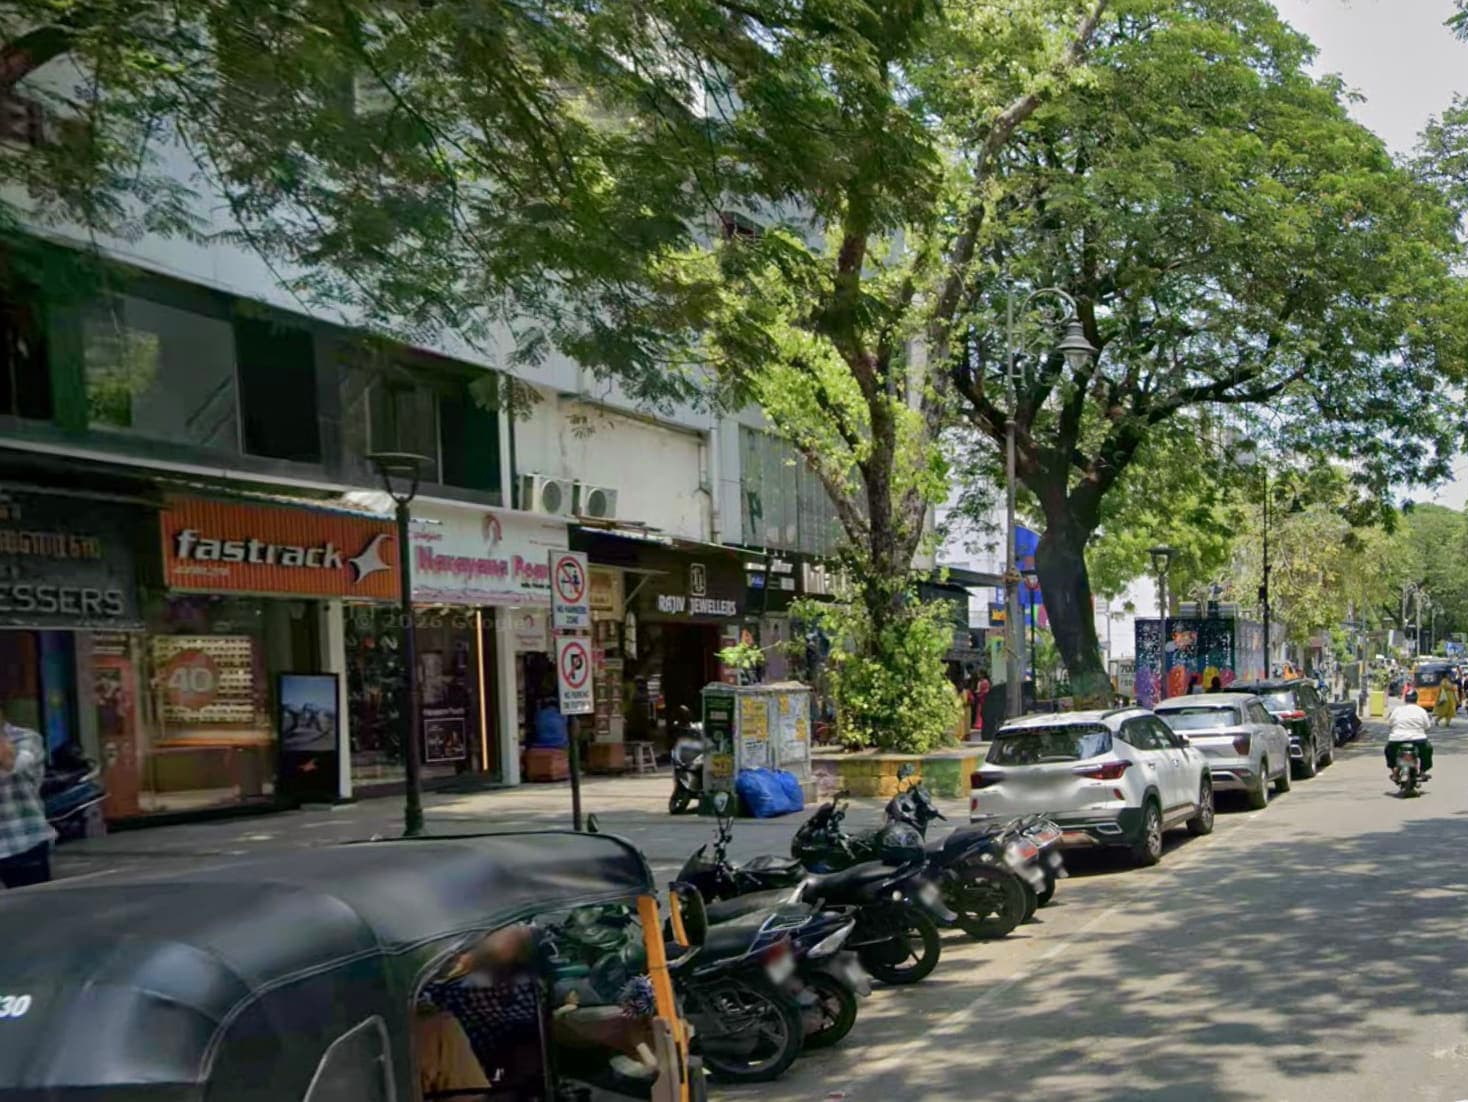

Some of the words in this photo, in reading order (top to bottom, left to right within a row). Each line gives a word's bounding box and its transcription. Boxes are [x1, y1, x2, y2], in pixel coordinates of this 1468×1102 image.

[177, 528, 343, 568] fastrack
[657, 594, 685, 614] RAJIV
[688, 598, 736, 616] JEWELLERS
[168, 666, 212, 692] 40
